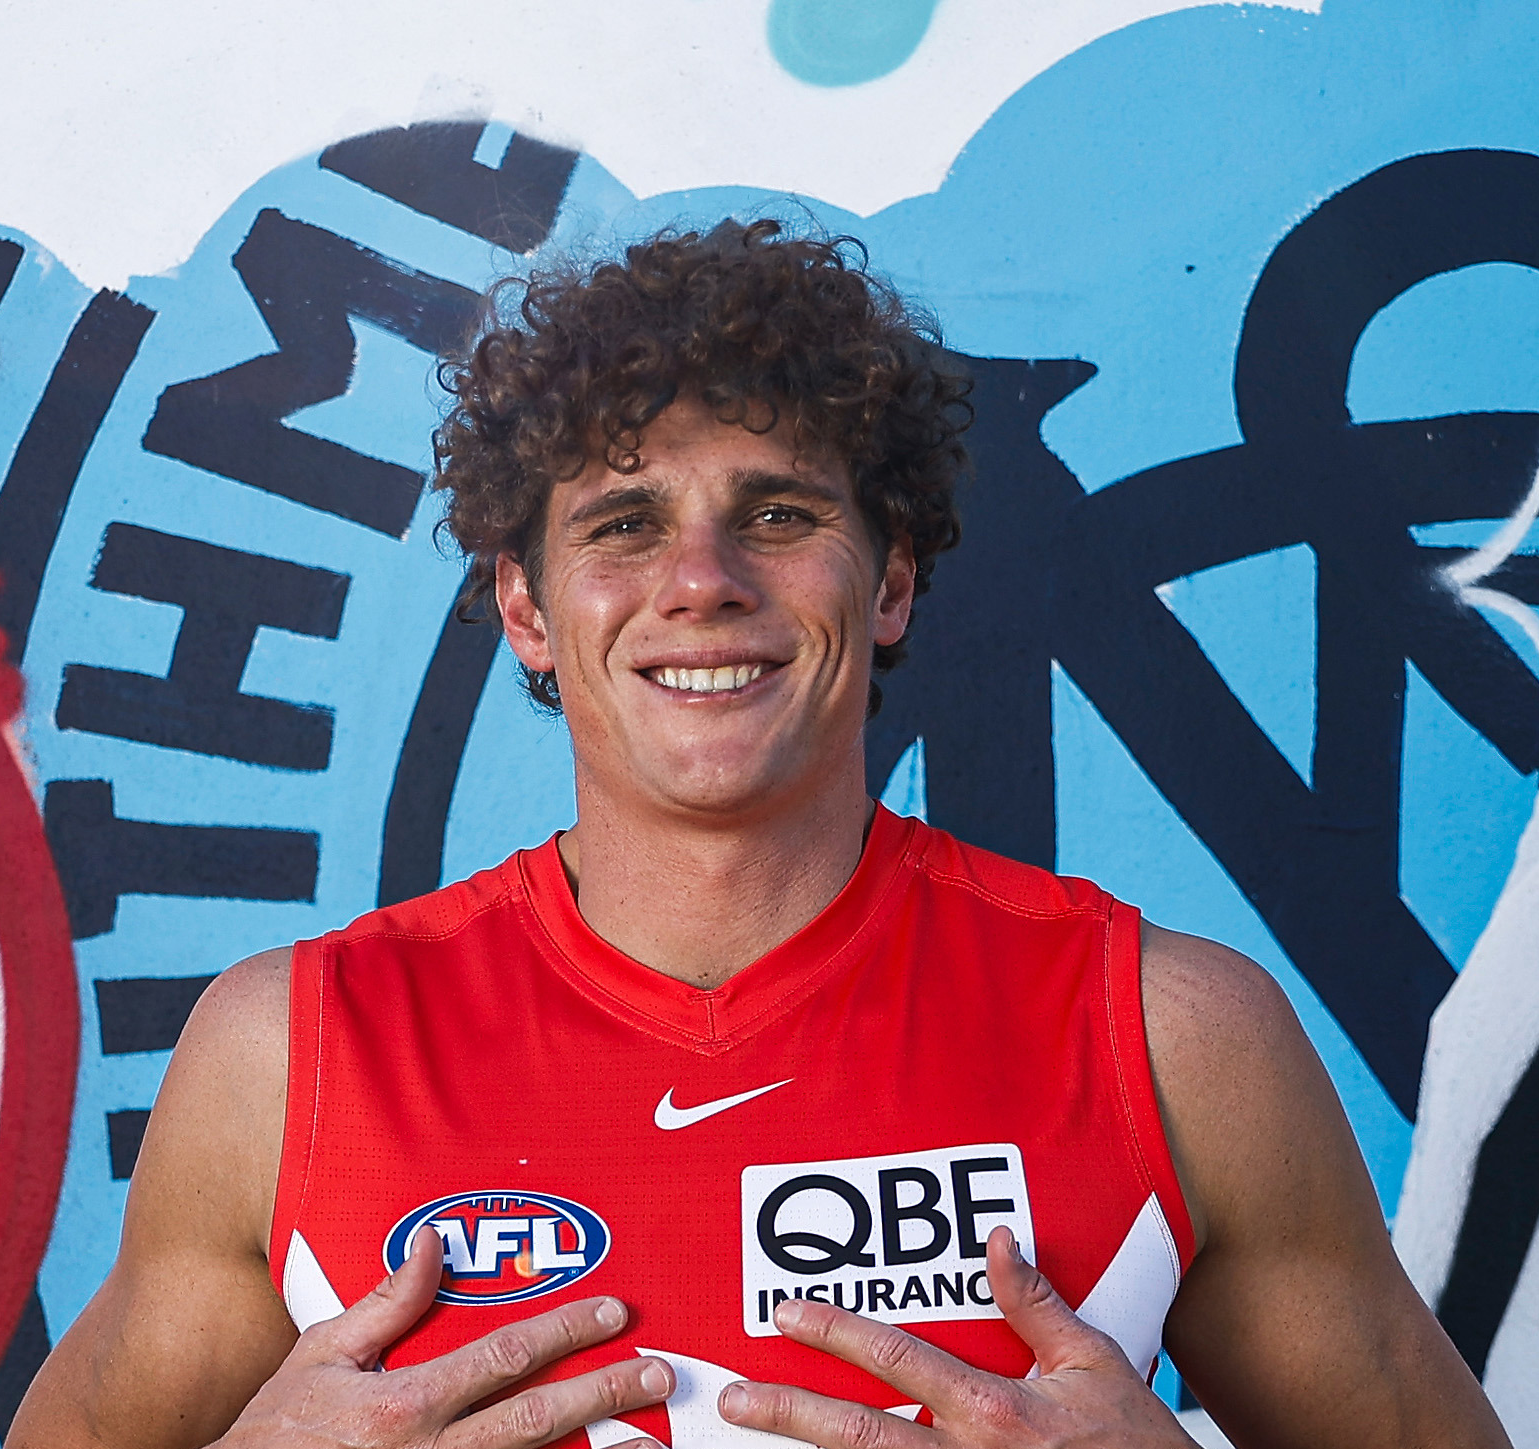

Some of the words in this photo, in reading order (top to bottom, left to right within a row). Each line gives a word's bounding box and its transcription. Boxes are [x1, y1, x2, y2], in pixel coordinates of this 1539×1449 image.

[757, 1157, 1019, 1275] QBE
[428, 1217, 587, 1273] AFL
[758, 1270, 994, 1323] ISURANC
